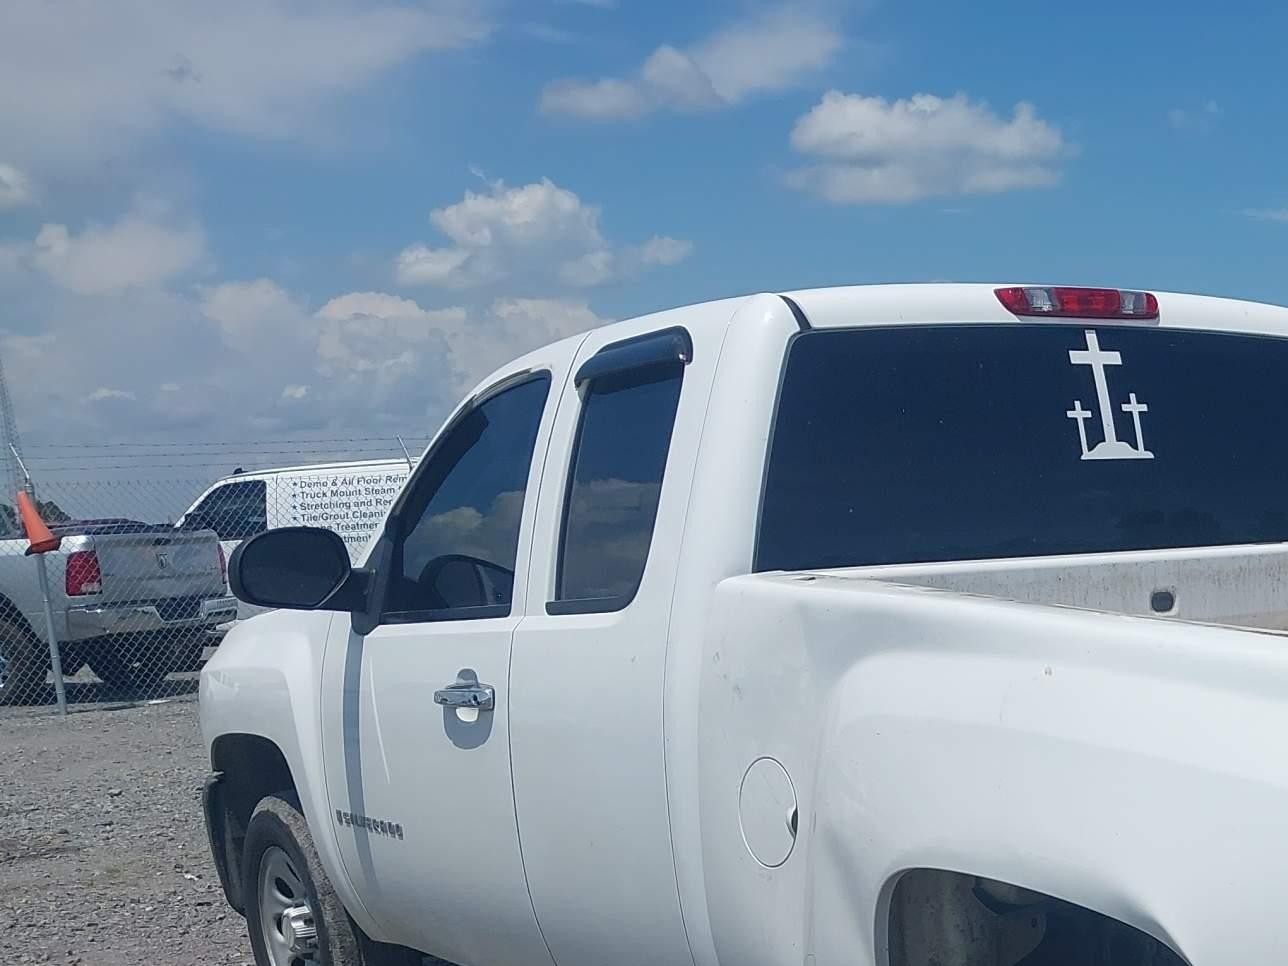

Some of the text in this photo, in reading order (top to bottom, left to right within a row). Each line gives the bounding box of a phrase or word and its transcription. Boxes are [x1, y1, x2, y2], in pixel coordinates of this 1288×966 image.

[300, 480, 328, 489] Demo
[331, 478, 338, 487] &
[341, 477, 353, 486] All
[357, 475, 382, 485] Floor
[300, 490, 328, 500] Truck
[330, 488, 361, 498] Mount
[364, 486, 396, 496] Steam
[300, 500, 351, 511] Stretching
[353, 498, 373, 507] and
[301, 511, 350, 522] Tile/Grout
